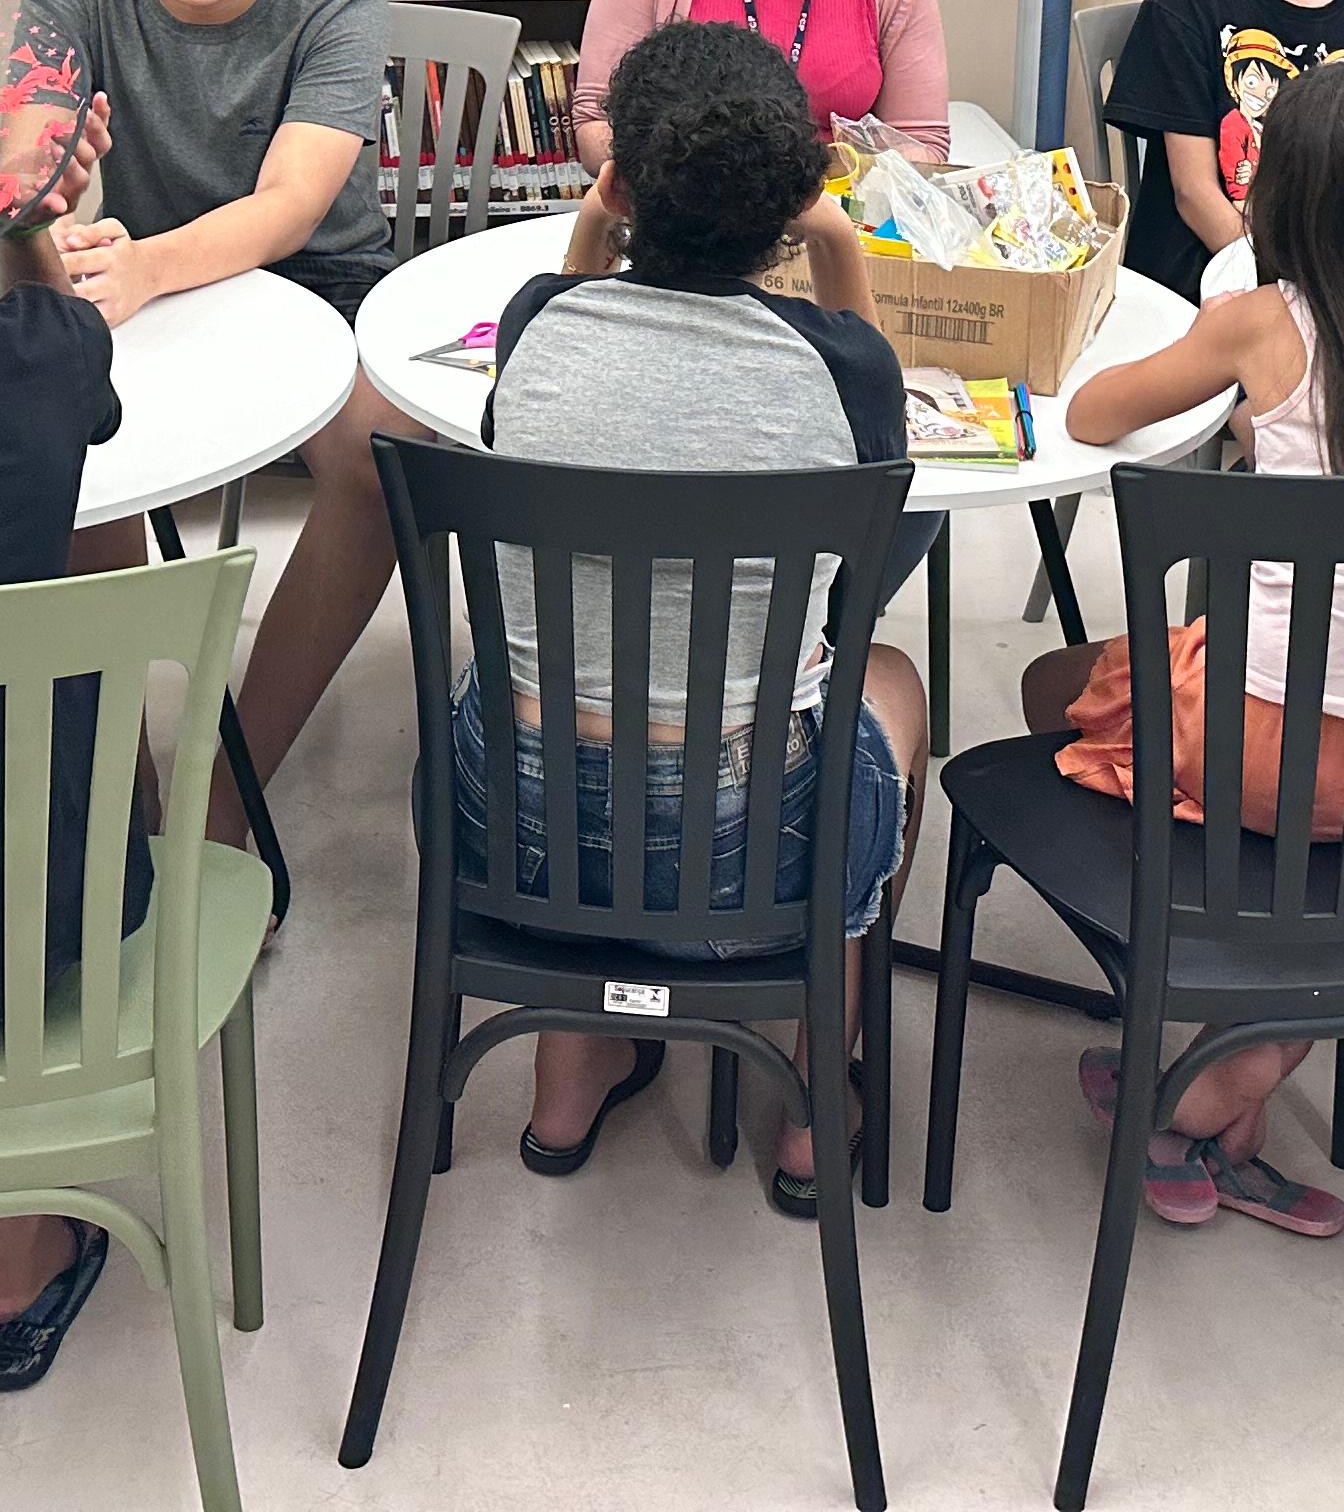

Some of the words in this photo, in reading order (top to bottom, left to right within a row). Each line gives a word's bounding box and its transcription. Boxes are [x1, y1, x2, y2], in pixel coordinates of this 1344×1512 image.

[763, 275, 784, 289] 66
[911, 294, 943, 310] Infantil
[946, 300, 987, 319] 12x400g
[989, 304, 1005, 318] BR
